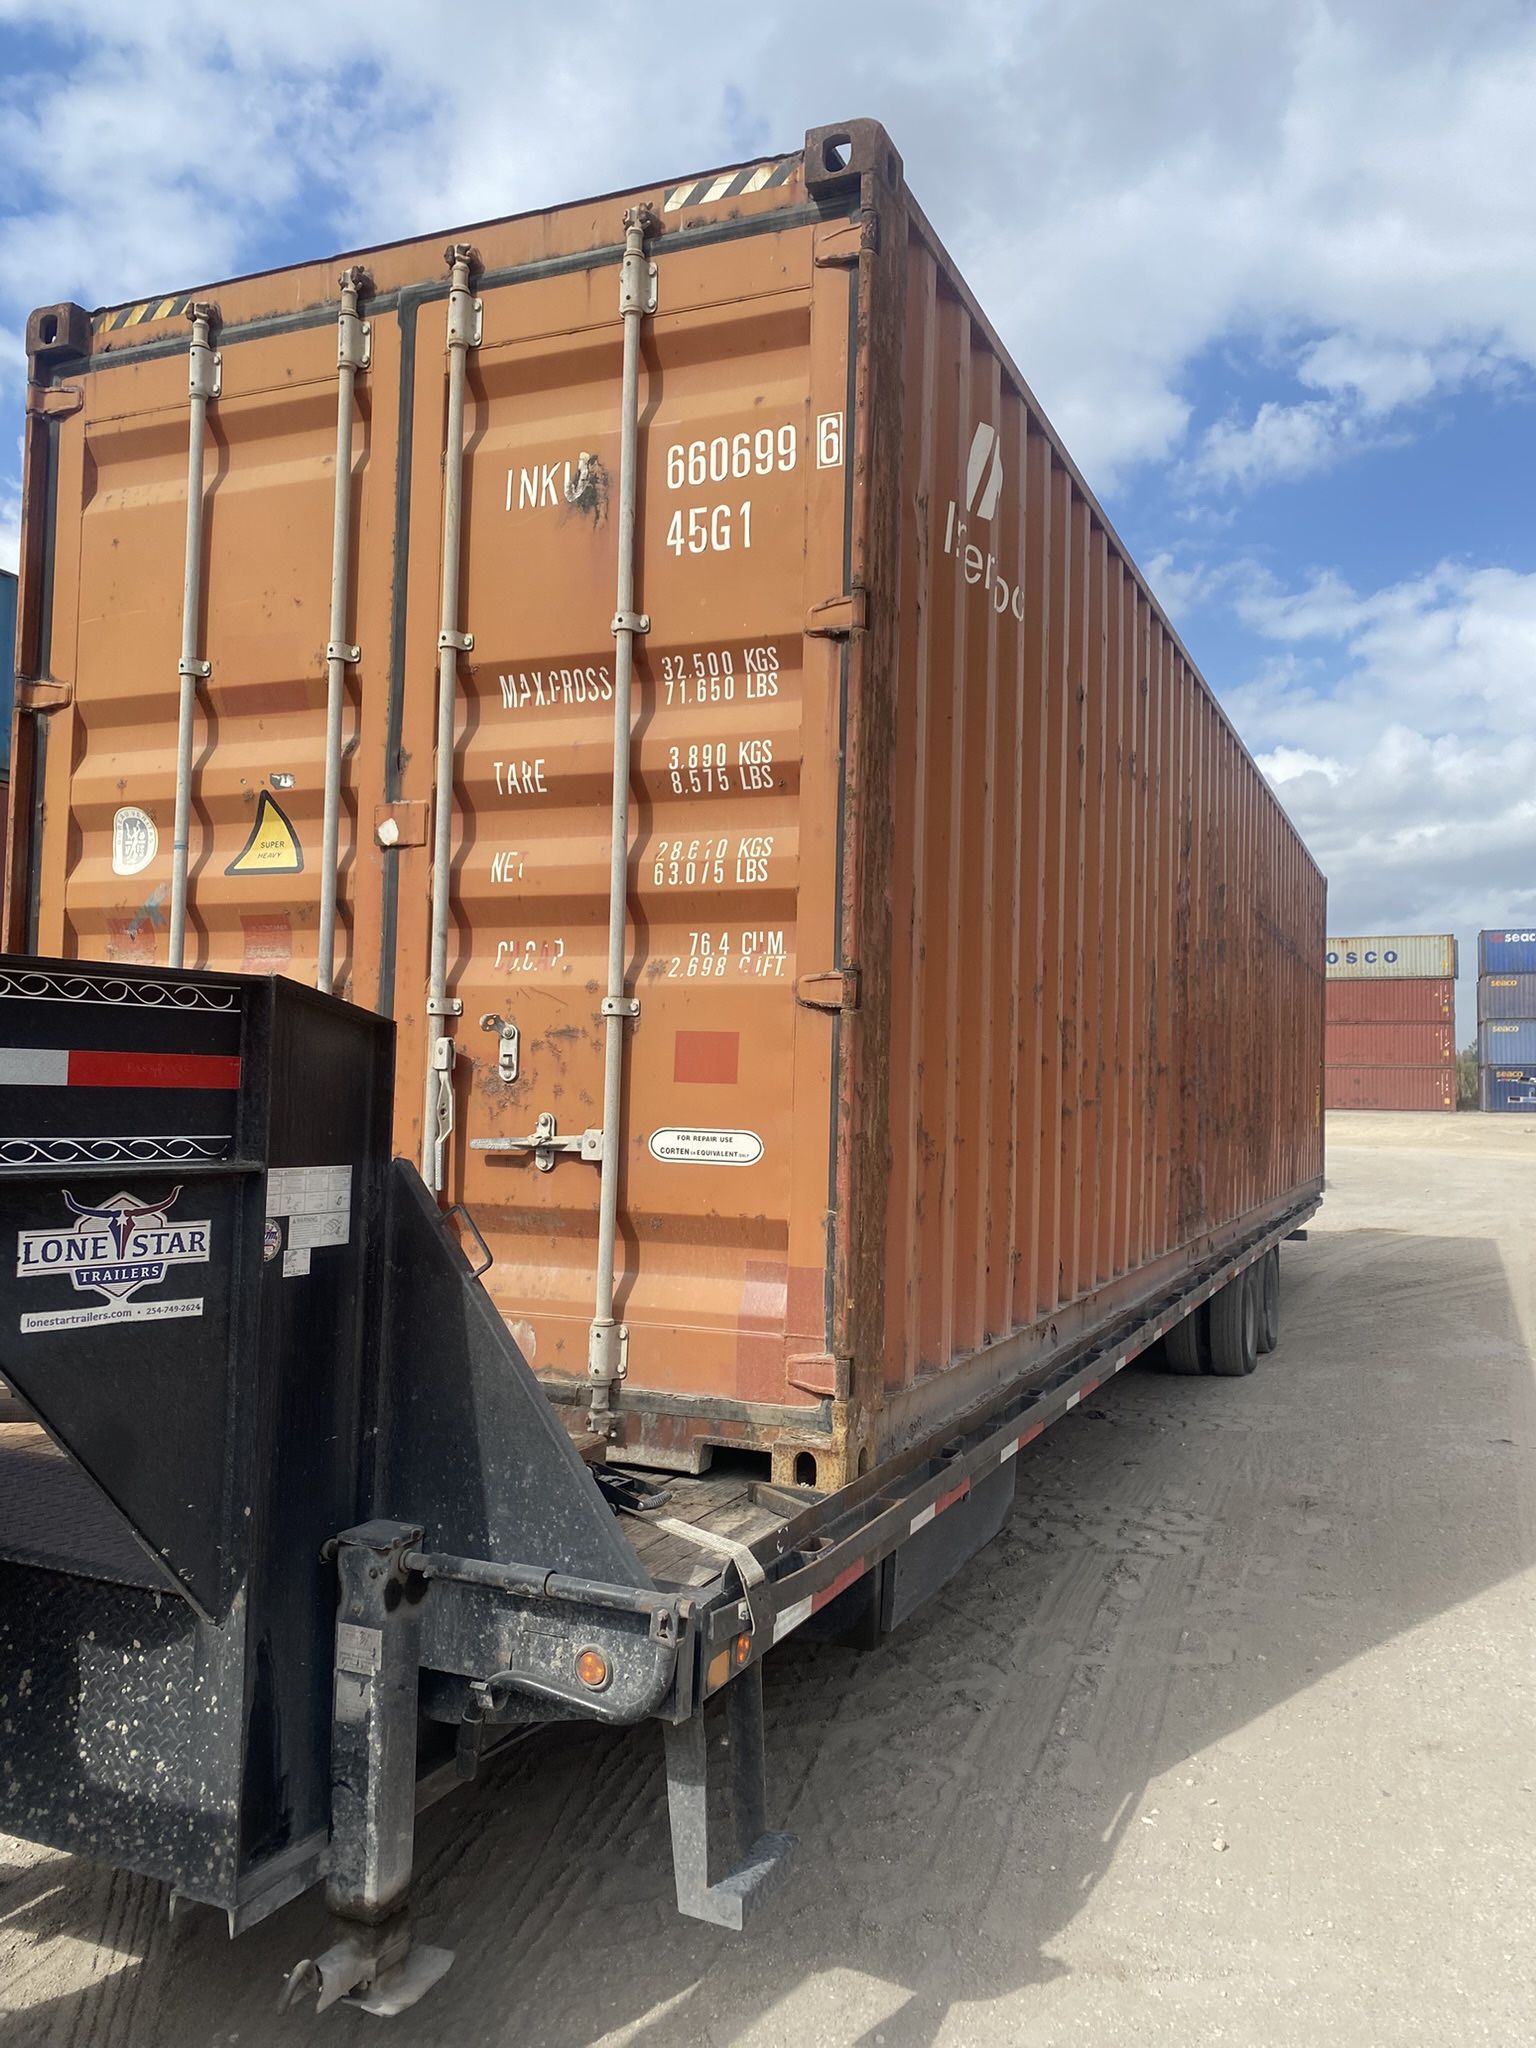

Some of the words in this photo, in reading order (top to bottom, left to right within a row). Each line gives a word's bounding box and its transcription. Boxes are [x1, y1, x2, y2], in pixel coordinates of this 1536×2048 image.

[505, 452, 590, 511] INKU
[667, 424, 797, 490] 660699
[819, 415, 840, 466] 6
[666, 500, 752, 556] 45G1
[744, 646, 780, 673] KGS
[746, 672, 779, 699] LBS
[494, 758, 548, 795] TARE
[738, 739, 773, 766] KGS
[740, 764, 774, 790] LBS
[260, 840, 285, 849] SUPER
[737, 836, 774, 859] KGS
[736, 858, 768, 883] LBS
[689, 931, 730, 956] 76.4
[676, 1134, 691, 1142] FOR
[693, 1135, 717, 1143] REPAIR
[660, 1146, 690, 1156] CORTEN
[697, 1149, 738, 1158] EQUIVALENT
[21, 1235, 109, 1266] LONE
[132, 1229, 207, 1258] STAR
[80, 1264, 160, 1283] TRAILERS
[26, 1308, 132, 1328] lonestartrailers.com
[146, 1303, 201, 1315] 254-749-2624
